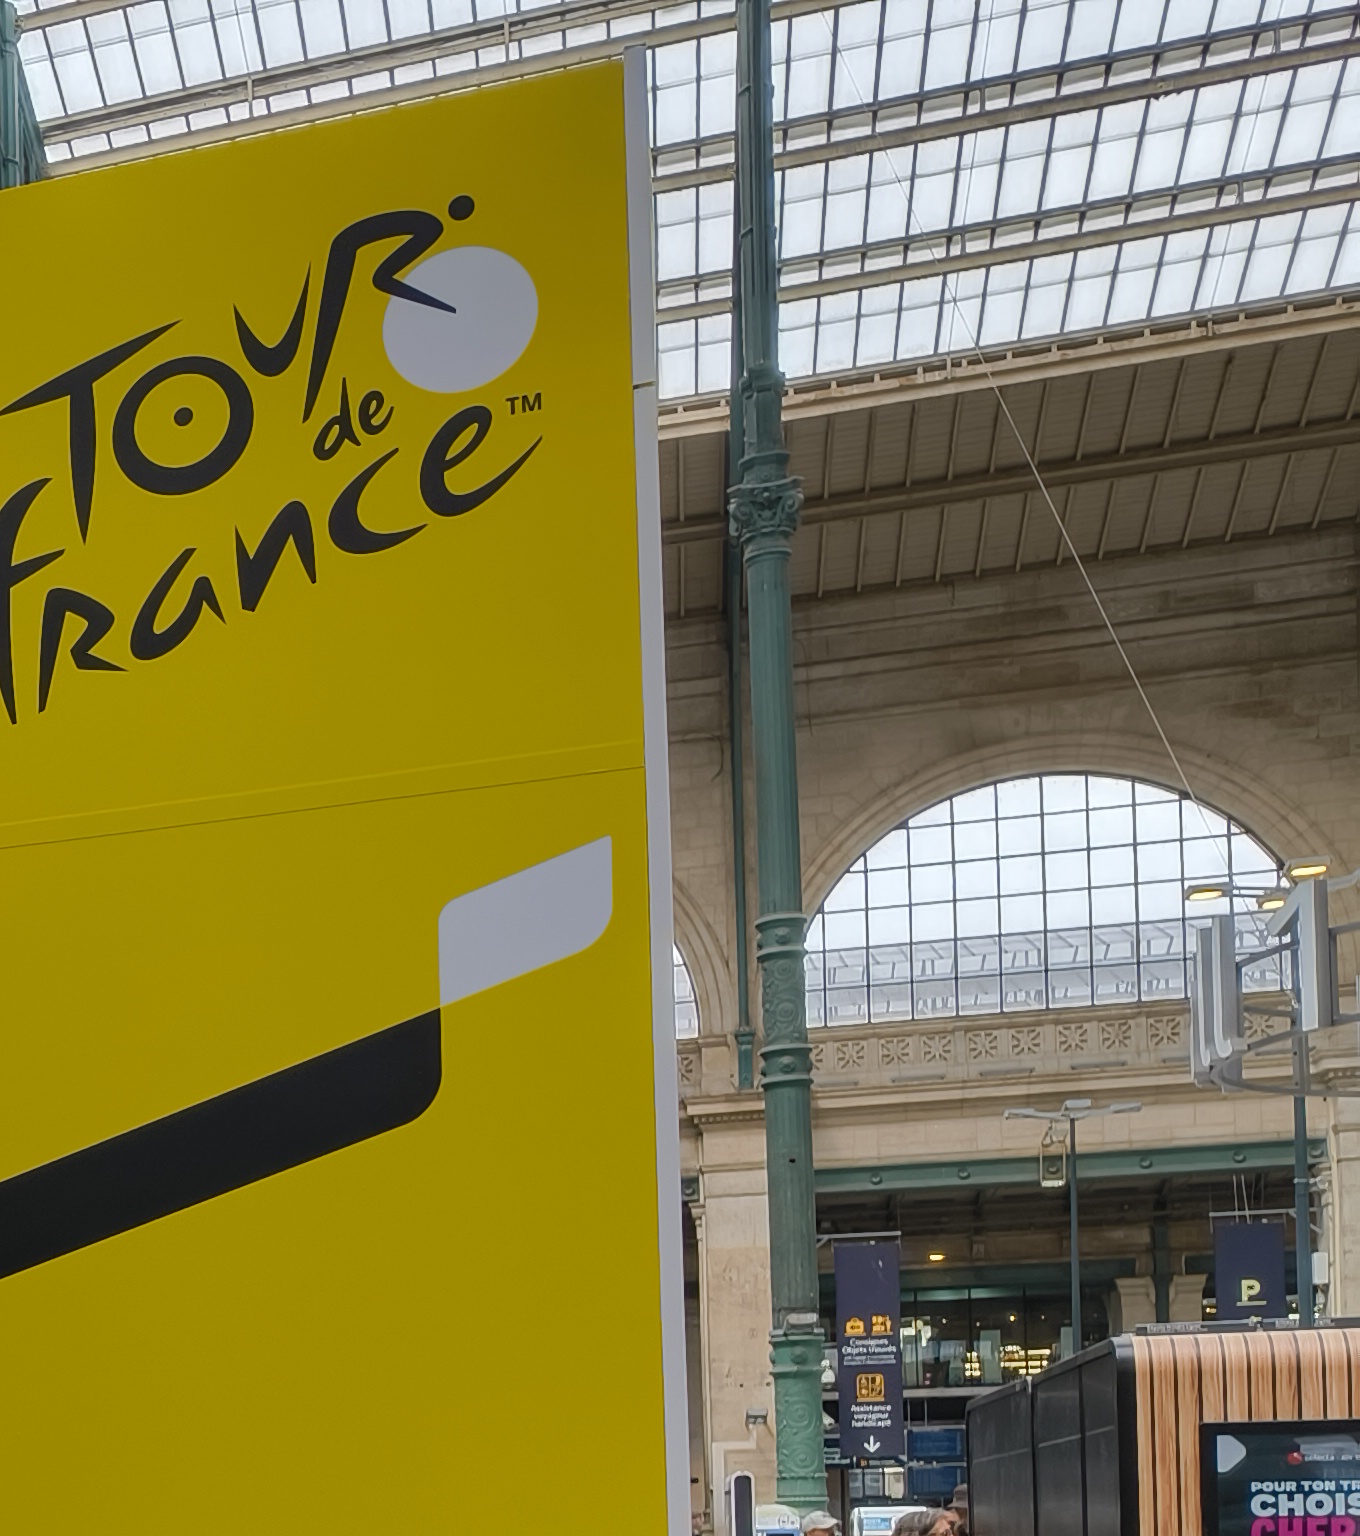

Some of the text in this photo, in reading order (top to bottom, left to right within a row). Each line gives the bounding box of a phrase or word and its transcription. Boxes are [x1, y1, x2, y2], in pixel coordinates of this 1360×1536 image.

[313, 378, 395, 461] de
[1251, 1481, 1297, 1493] POUR
[1301, 1480, 1336, 1492] TON
